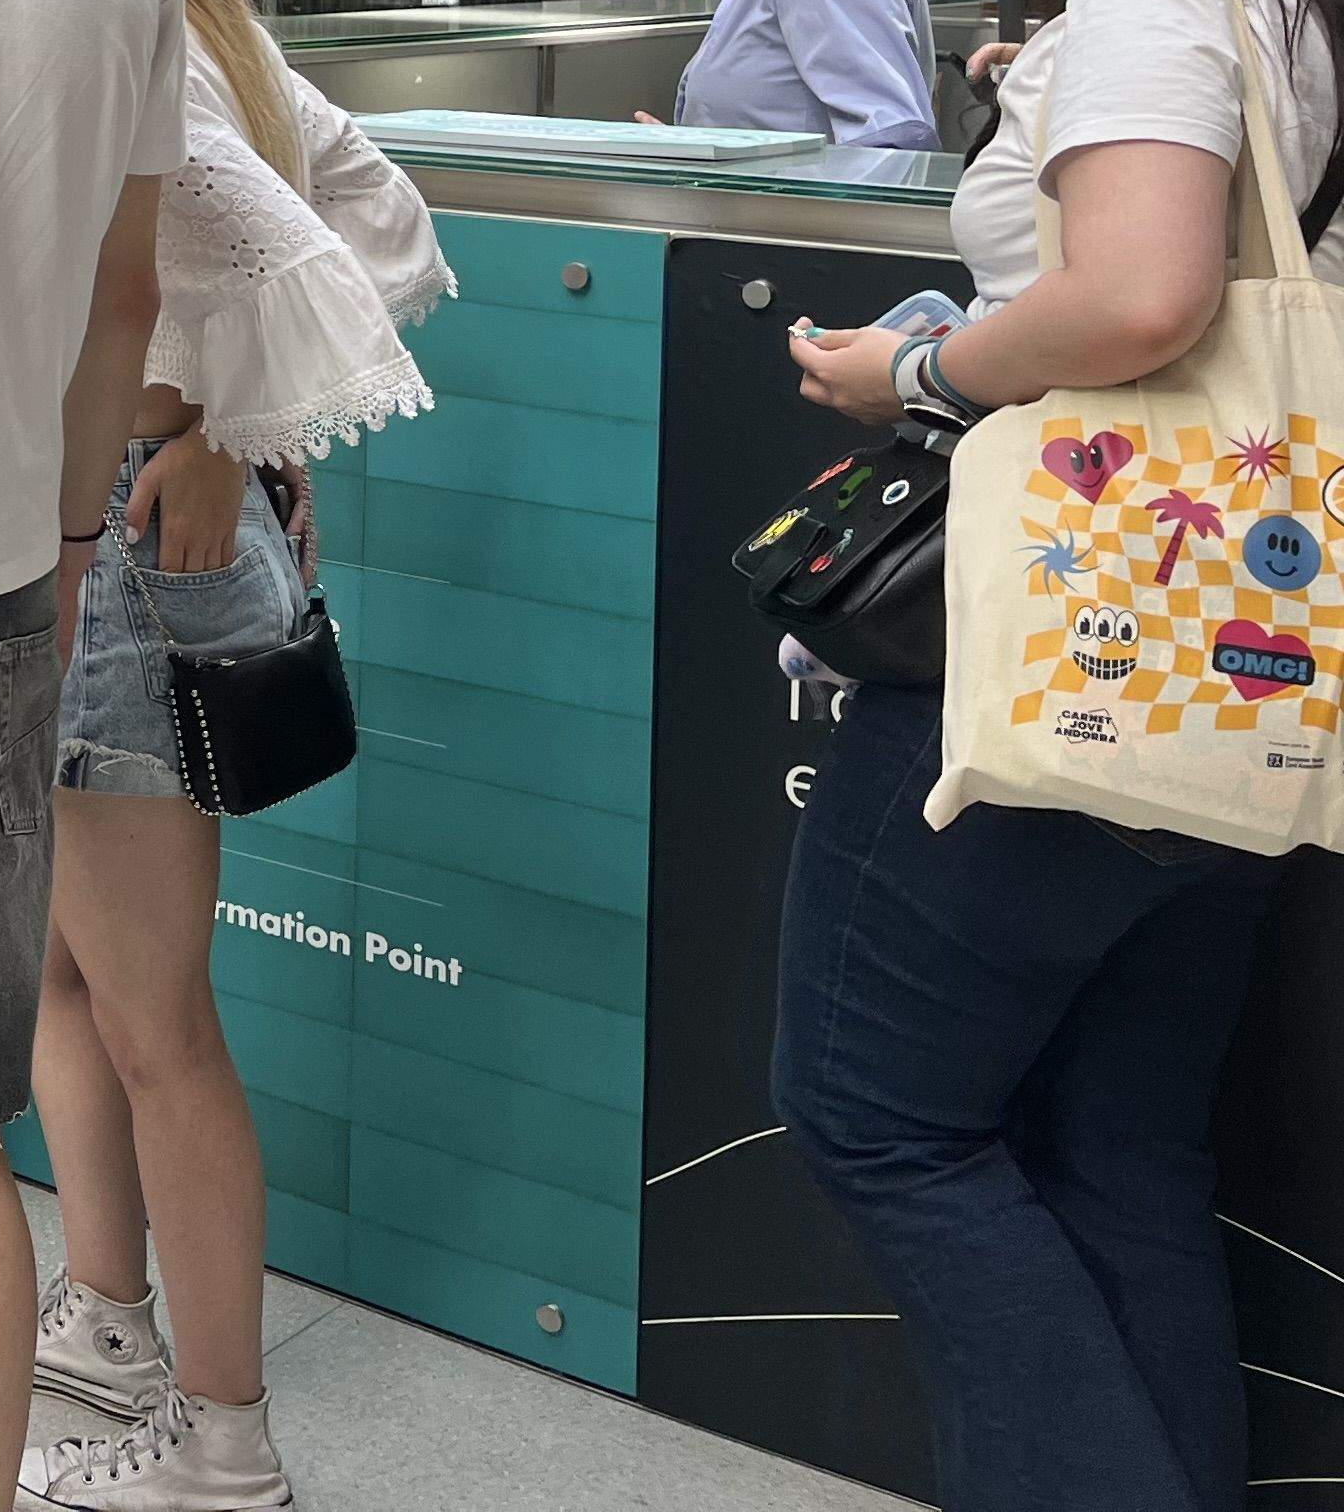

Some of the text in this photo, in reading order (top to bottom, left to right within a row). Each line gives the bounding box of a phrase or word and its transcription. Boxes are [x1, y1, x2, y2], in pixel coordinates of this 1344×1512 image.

[1218, 648, 1308, 682] OMG!
[1061, 709, 1114, 725] CARNET
[1070, 720, 1103, 733] JOVE
[1054, 727, 1118, 745] ANDORRA
[214, 900, 463, 987] rmation Point
